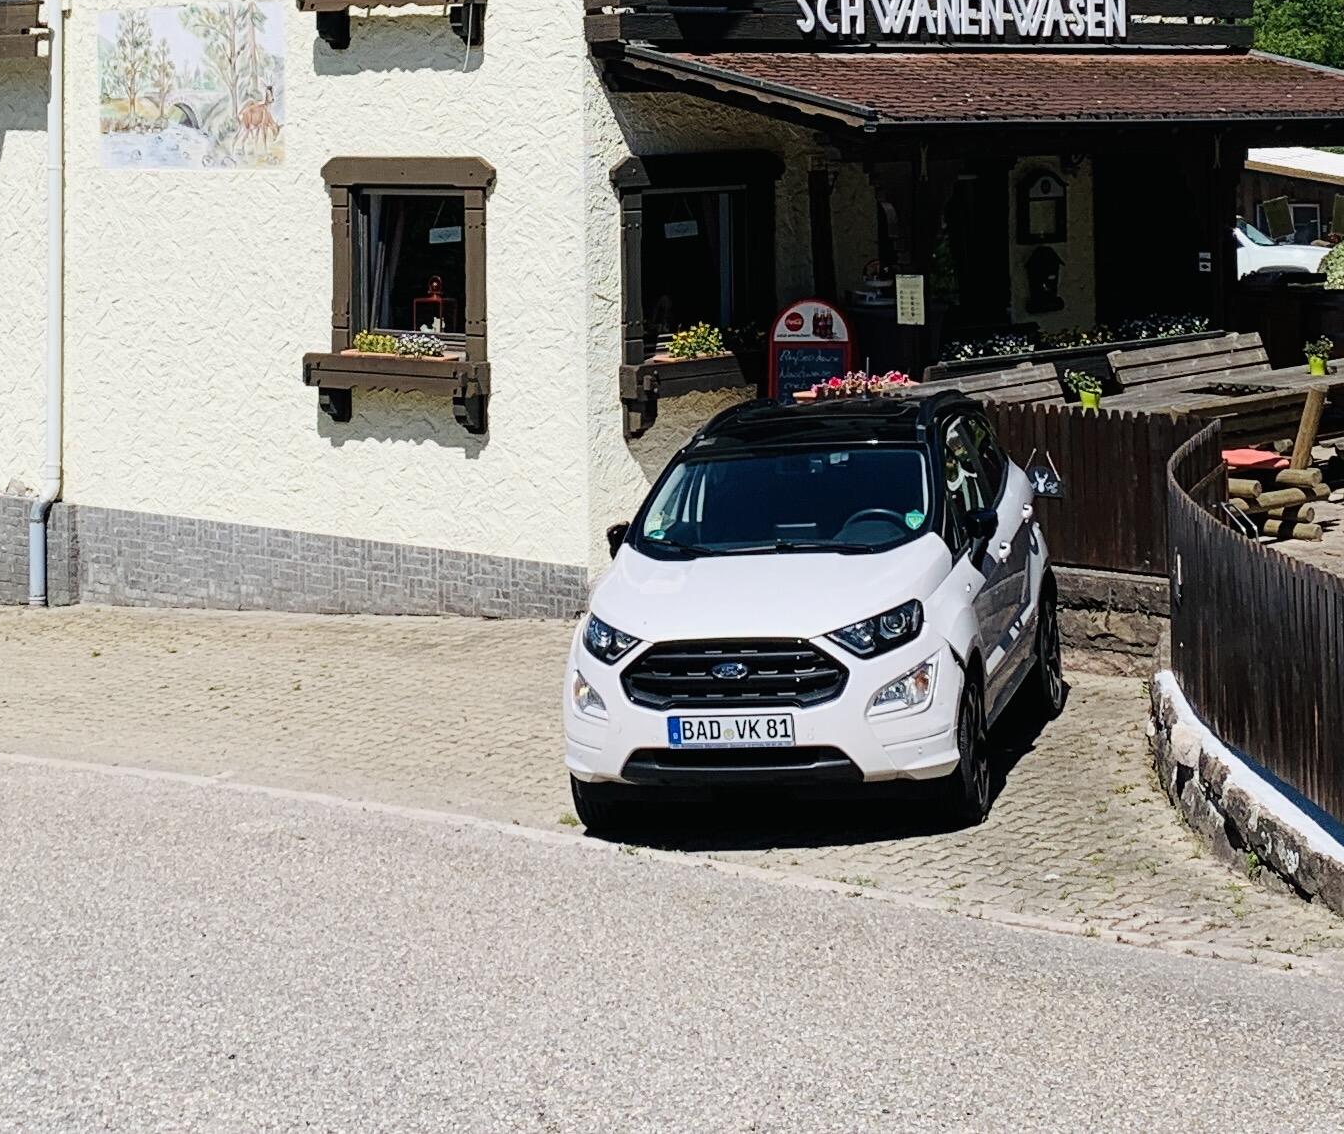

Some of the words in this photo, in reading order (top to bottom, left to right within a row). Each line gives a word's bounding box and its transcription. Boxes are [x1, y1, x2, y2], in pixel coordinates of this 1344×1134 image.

[682, 720, 721, 740] BAD
[735, 719, 761, 739] VK
[766, 718, 791, 738] 81
